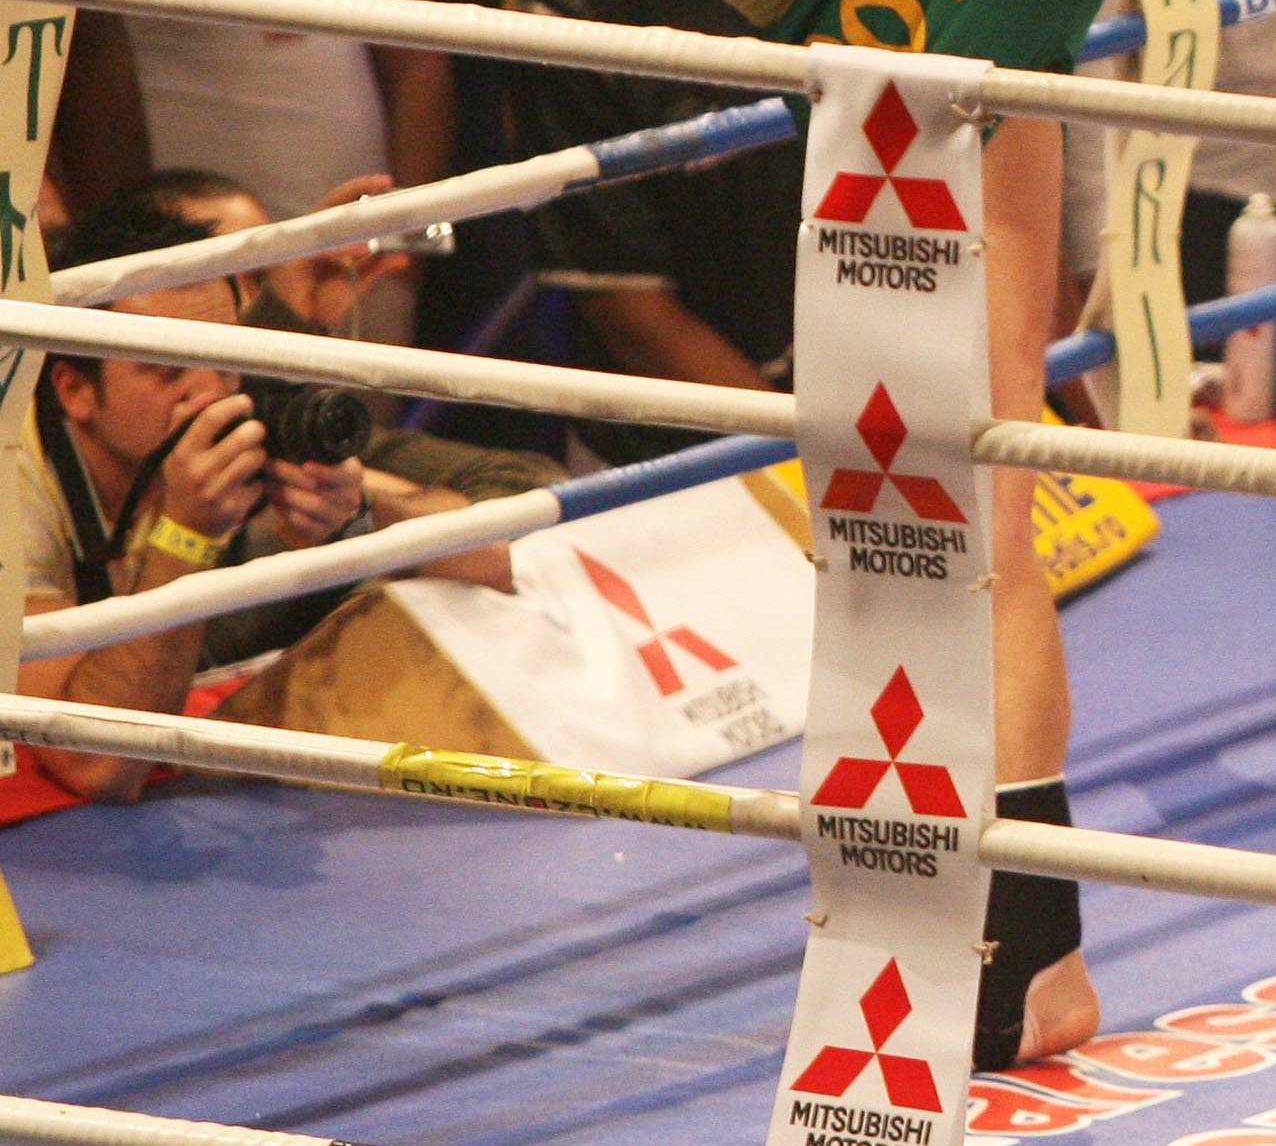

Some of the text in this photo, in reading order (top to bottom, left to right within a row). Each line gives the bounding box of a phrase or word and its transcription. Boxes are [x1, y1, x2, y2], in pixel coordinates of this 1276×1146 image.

[818, 227, 961, 266] MITSUBISHI
[836, 260, 937, 293] MOTORS
[828, 515, 968, 554] MITSUBISHI
[850, 549, 949, 581] MOTORS
[816, 813, 960, 852] MITSUBISHI
[839, 843, 938, 878] MOTORS
[789, 1100, 933, 1146] MITSUBISHI
